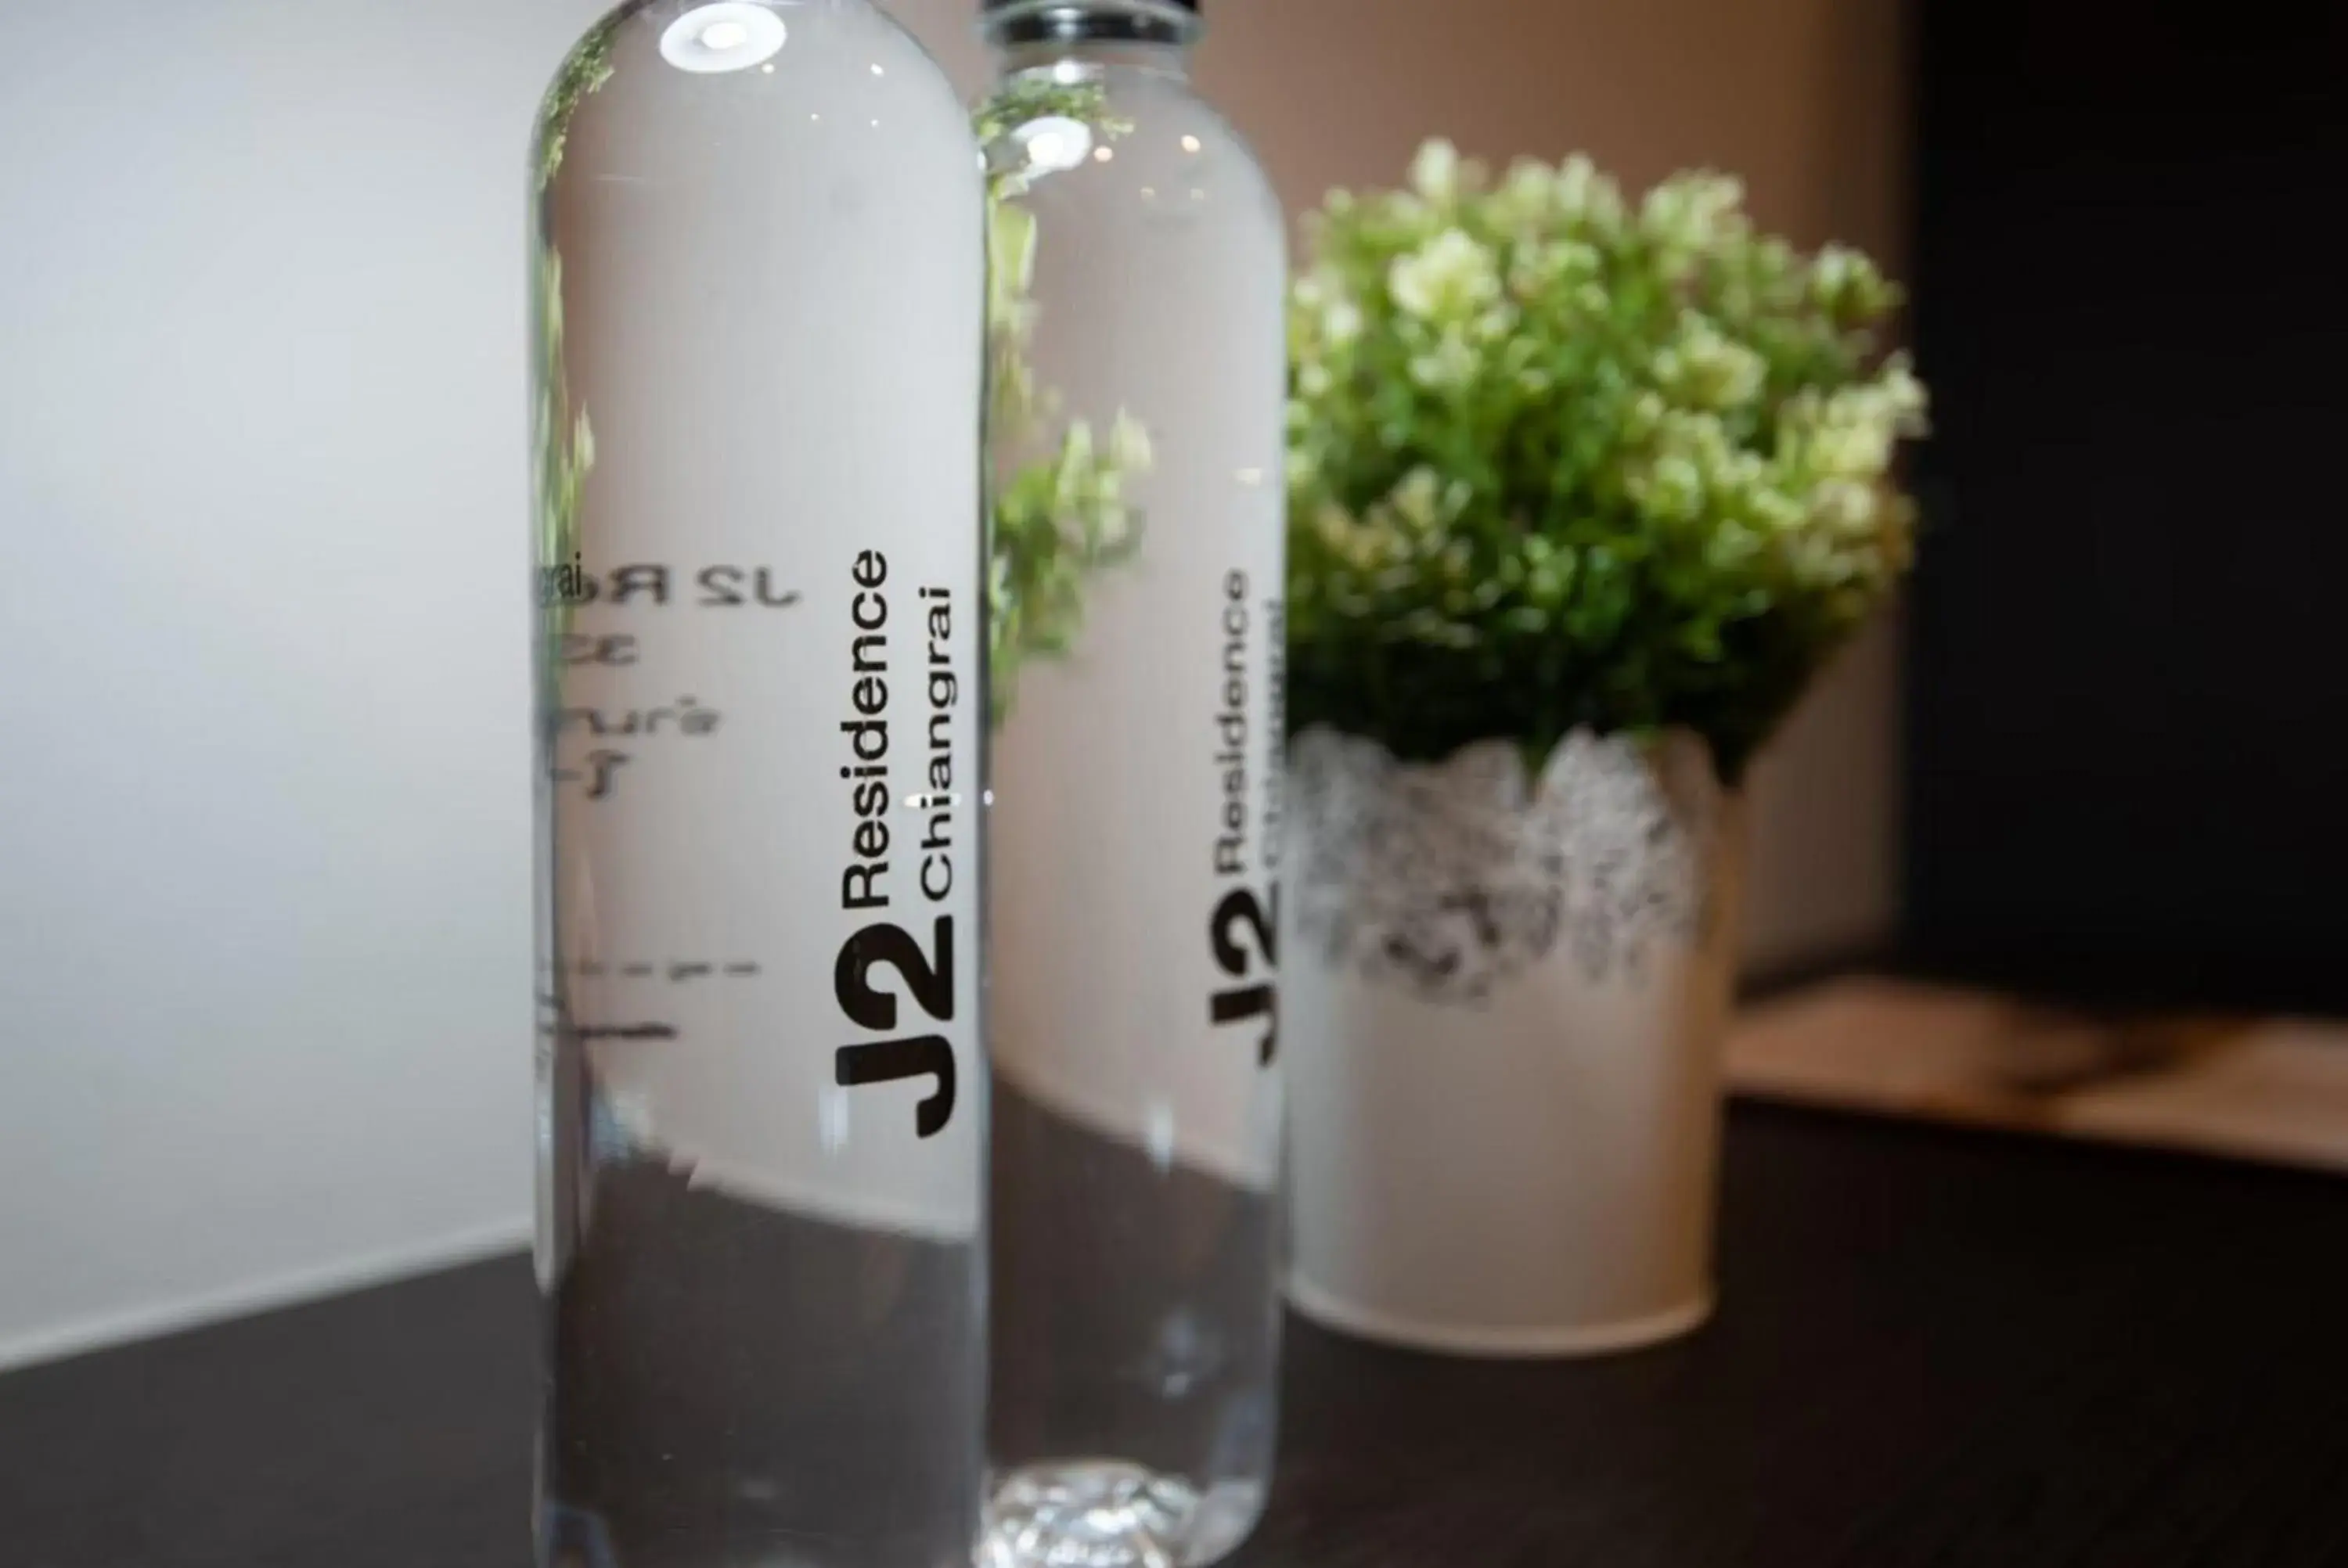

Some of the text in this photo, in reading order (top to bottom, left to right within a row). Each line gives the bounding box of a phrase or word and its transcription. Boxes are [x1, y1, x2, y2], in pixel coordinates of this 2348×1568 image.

[834, 549, 956, 1138] J2 Residence
[918, 586, 958, 901] Chiangrai
[1214, 569, 1251, 876] Residence
[1208, 880, 1280, 1068] J2
